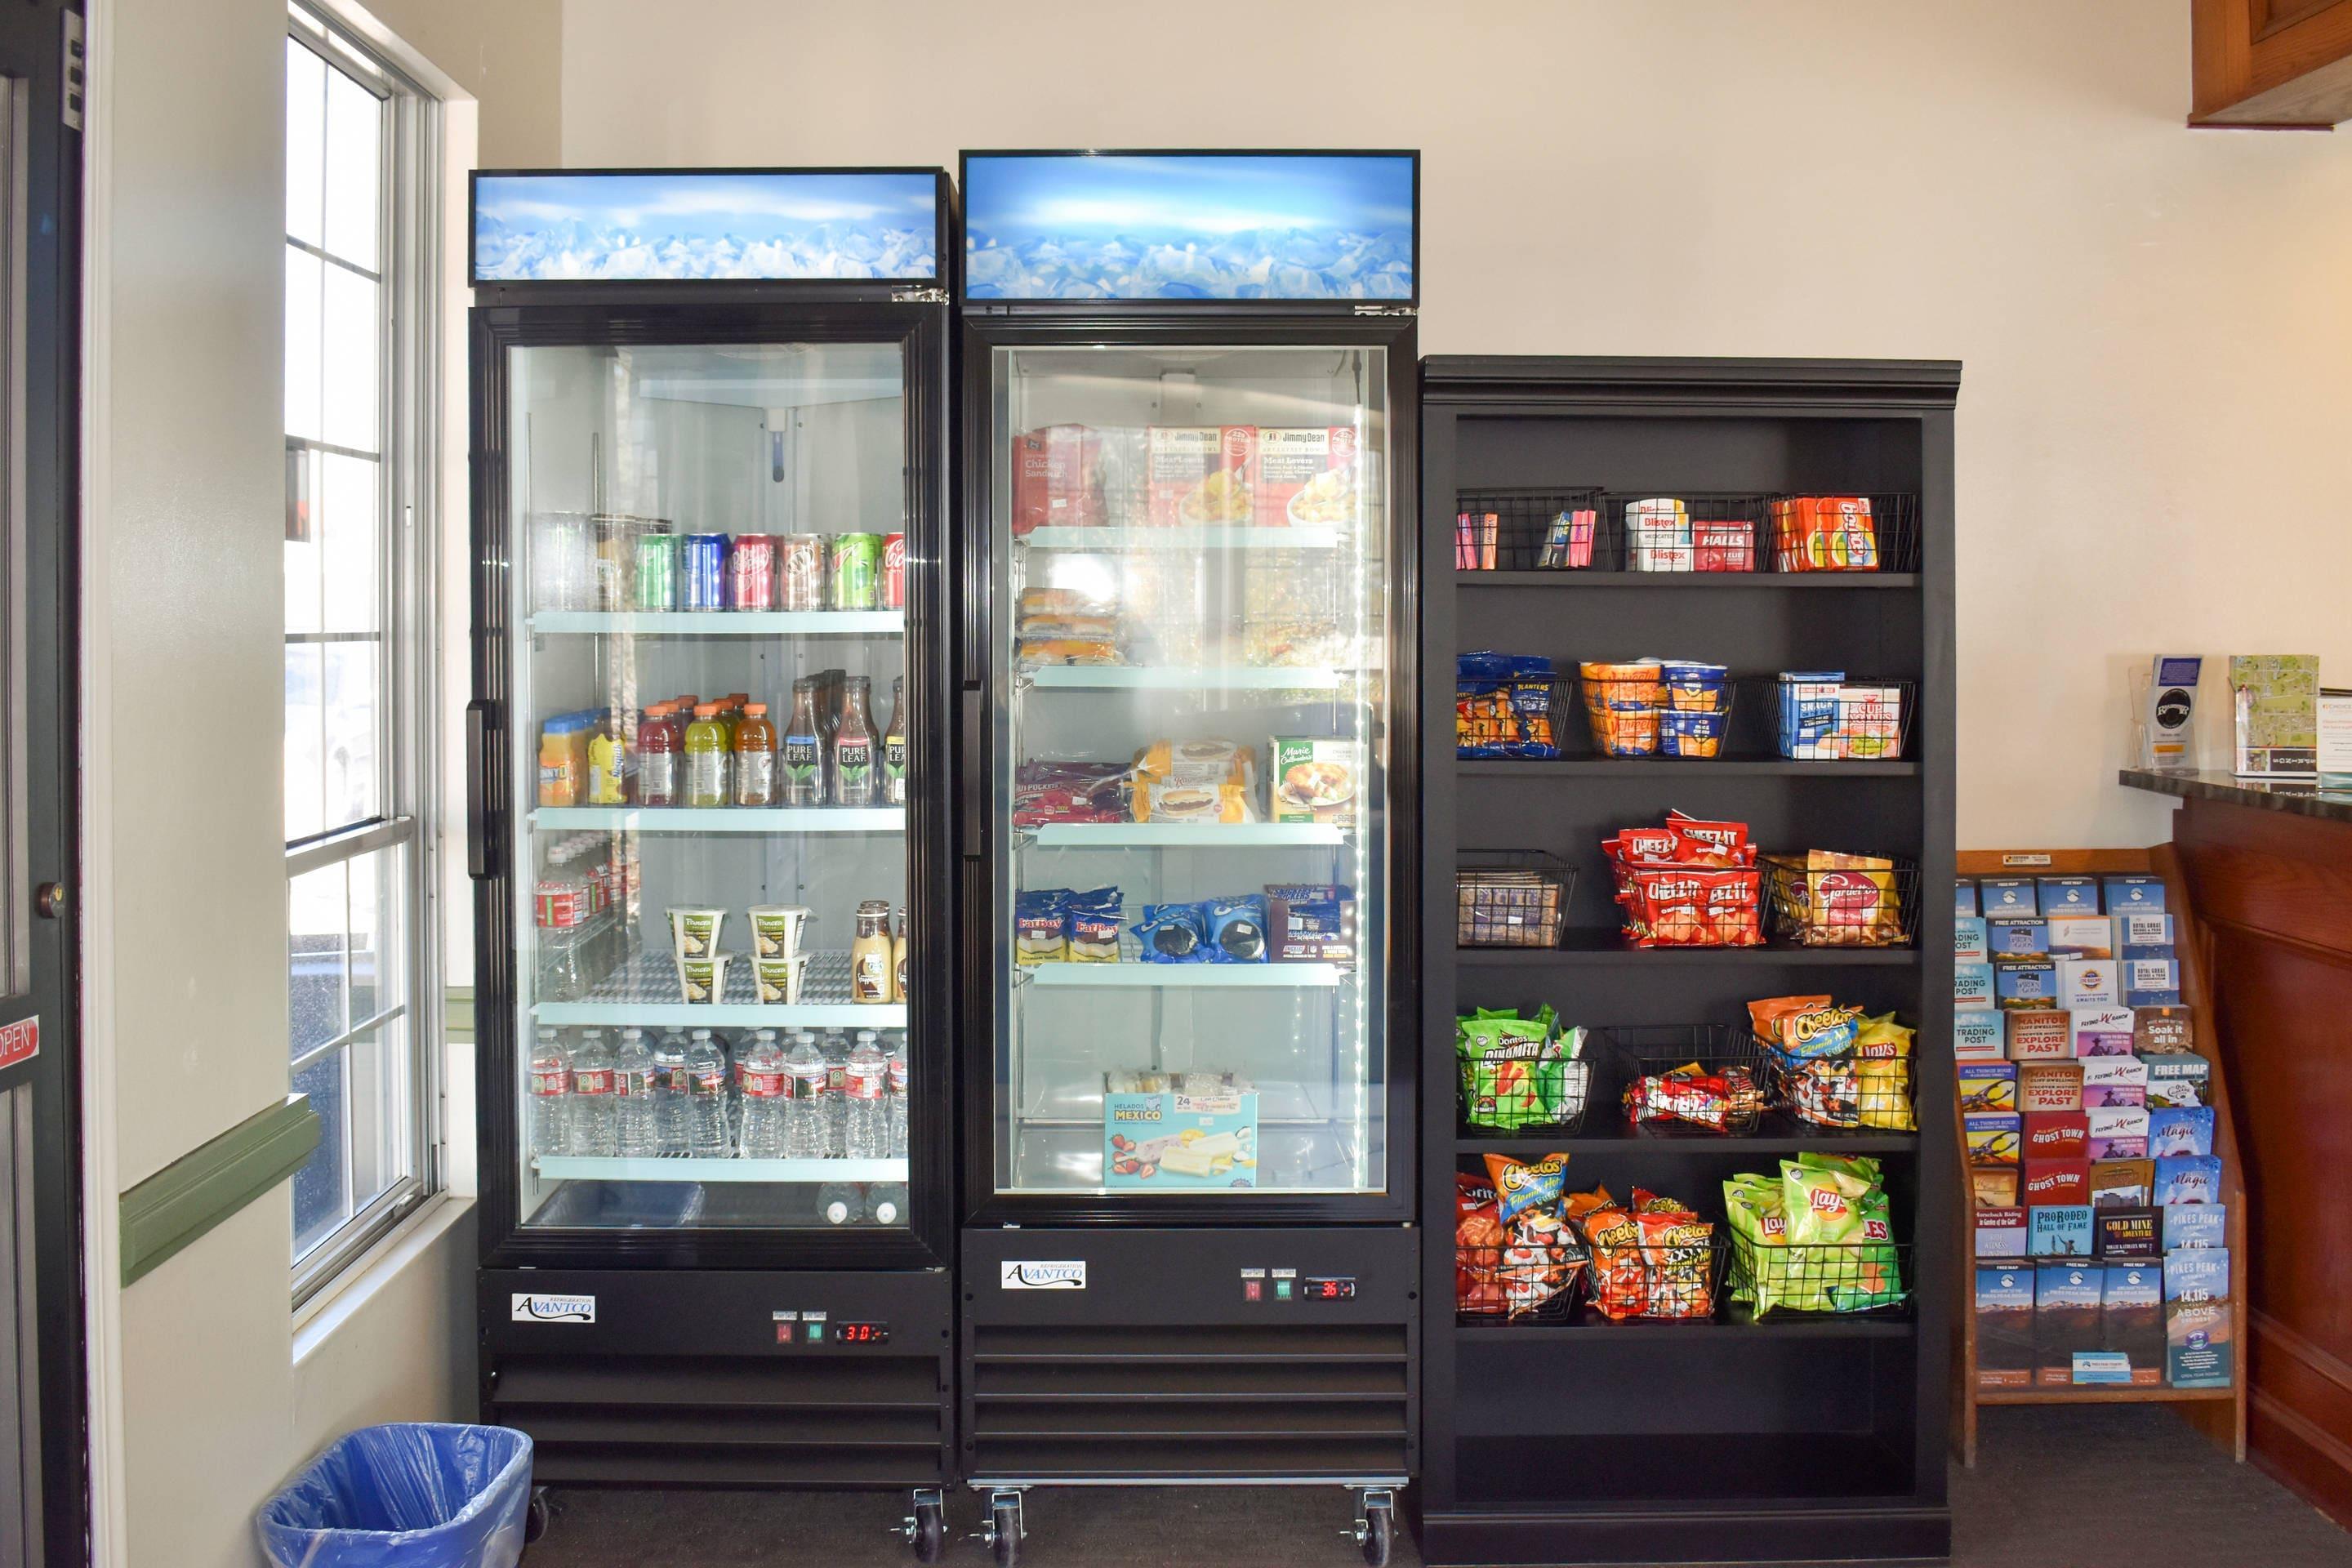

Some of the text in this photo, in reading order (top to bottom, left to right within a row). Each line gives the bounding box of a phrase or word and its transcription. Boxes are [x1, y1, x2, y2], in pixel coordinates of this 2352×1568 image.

[1174, 431, 1217, 443] Jimmy Dean
[1282, 431, 1325, 443] Jimmy Dean
[1026, 459, 1066, 469] Chicken
[1645, 518, 1676, 528] Blistex
[1702, 536, 1744, 546] HALLS
[1650, 549, 1686, 562] Blistex
[1800, 702, 1833, 712] SNACK
[1859, 703, 1882, 714] CUP
[1847, 713, 1891, 724] NOODLES
[787, 746, 812, 755] PURE
[1281, 746, 1311, 758] Marie
[787, 753, 812, 761] LEAF
[842, 755, 867, 763] LEAF
[1819, 874, 1878, 899] Gardetto's
[686, 918, 711, 926] Panera
[758, 918, 783, 926] Panera
[1019, 918, 1064, 929] FatBoy
[1076, 922, 1118, 935] FatBoy
[686, 965, 711, 973] Panera
[760, 965, 786, 973] Panera
[2100, 1013, 2114, 1023] W
[1795, 1008, 1852, 1042] Cheetos
[2148, 1025, 2183, 1034] Soak it
[1498, 1036, 1529, 1045] Doritos
[2154, 1034, 2177, 1044] all in
[1864, 1042, 1895, 1062] Lay's
[2027, 1044, 2061, 1052] PAST
[2114, 1066, 2127, 1076] W
[2154, 1064, 2208, 1075] FREE MAP
[1177, 1096, 1191, 1106] 24
[1648, 1089, 1722, 1124] Skittles
[1114, 1109, 1162, 1120] MEXICO
[2114, 1118, 2127, 1129] W
[2033, 1129, 2084, 1143] GHOST TOWN
[2158, 1125, 2195, 1140] Magic
[1503, 1160, 1563, 1192] Cheetos
[2171, 1173, 2208, 1188] Magic
[1544, 1178, 1561, 1189] Hot
[2029, 1174, 2081, 1191] GHOST TOWN
[1535, 1190, 1561, 1206] Puffs
[2106, 1219, 2153, 1230] GOLD MINE
[2173, 1214, 2219, 1224] PIKES PEAK
[1764, 1217, 1787, 1236] Lay
[1006, 1264, 1083, 1282] AVANTCO
[2170, 1263, 2216, 1274] PIKES PEAK
[1323, 1282, 1337, 1296] 36
[514, 1297, 592, 1316] AVANTCO
[2176, 1307, 2216, 1318] ABOVE
